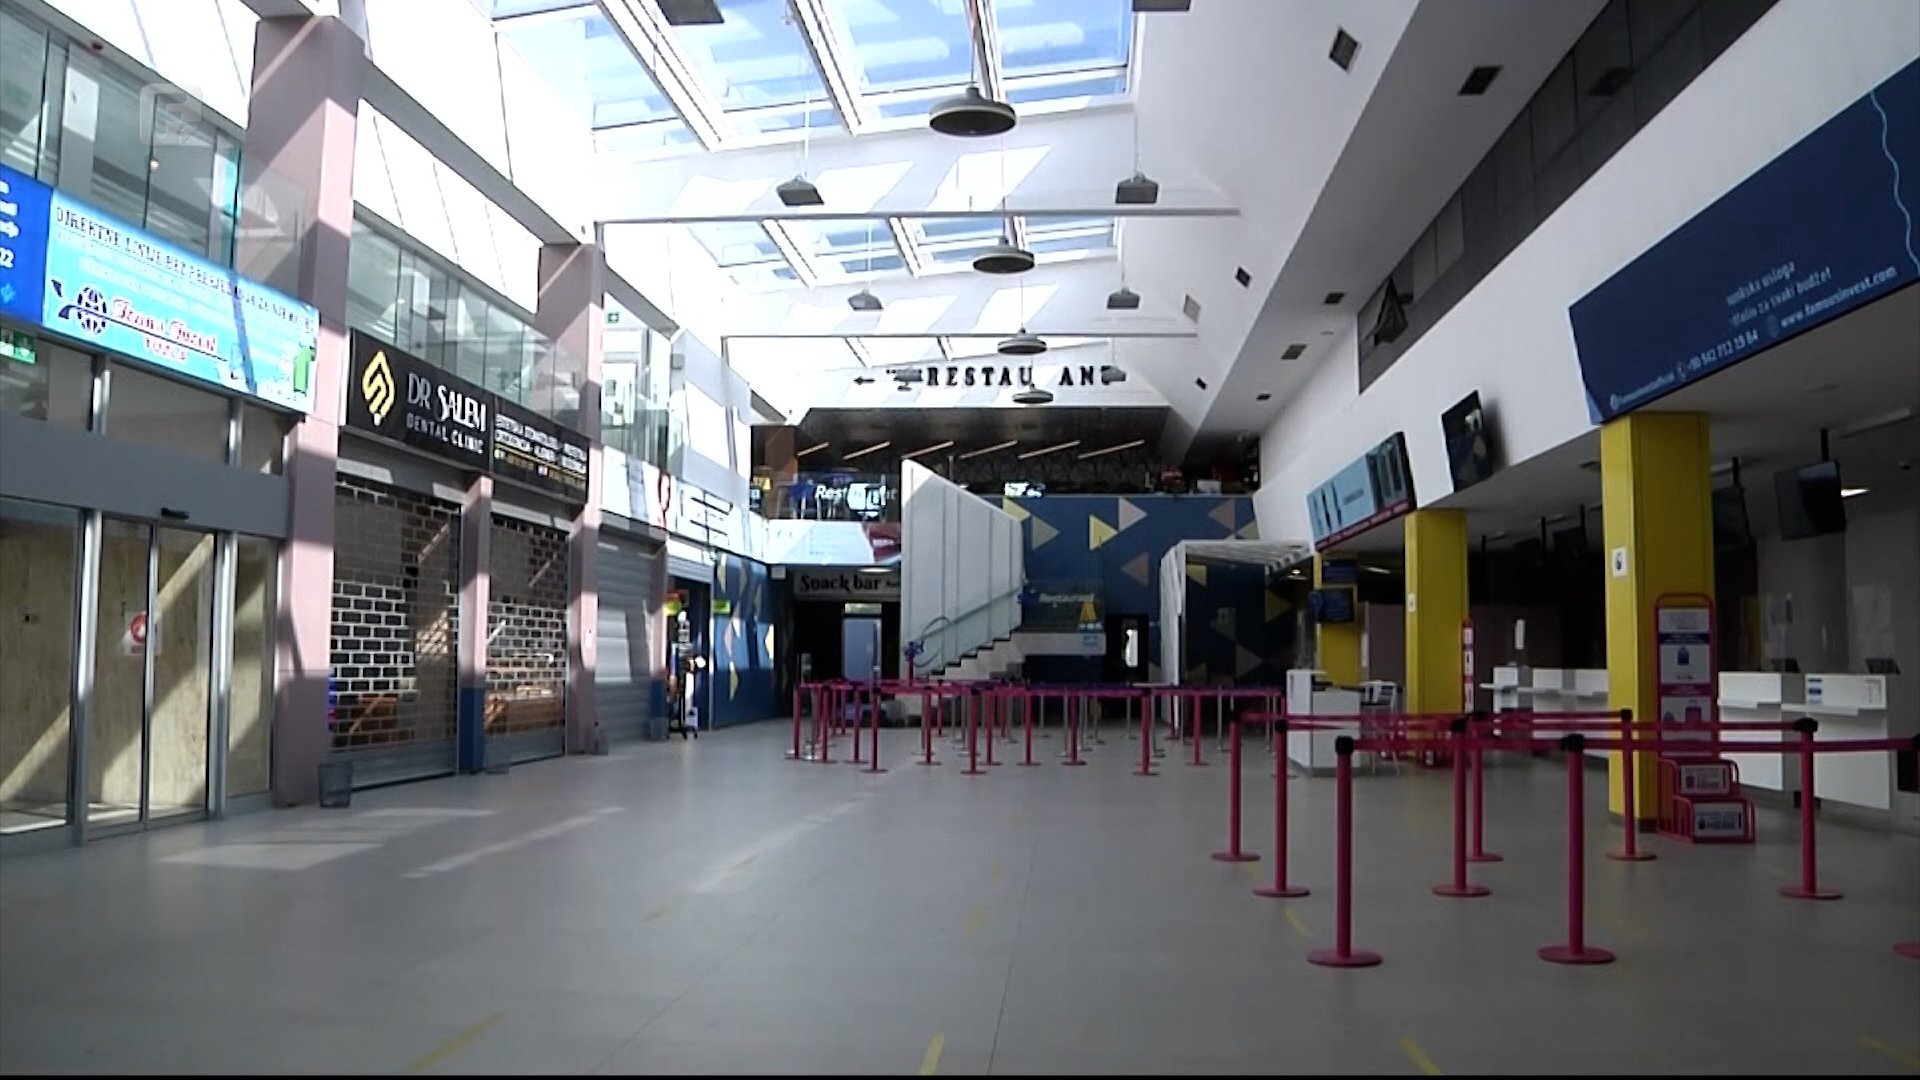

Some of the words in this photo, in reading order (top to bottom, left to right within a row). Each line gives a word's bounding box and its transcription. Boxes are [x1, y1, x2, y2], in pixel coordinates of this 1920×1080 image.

[407, 371, 432, 411] DR
[437, 384, 487, 433] SALEM
[405, 412, 449, 443] DENTAL
[452, 429, 484, 455] CLINIC
[853, 574, 882, 590] bar
